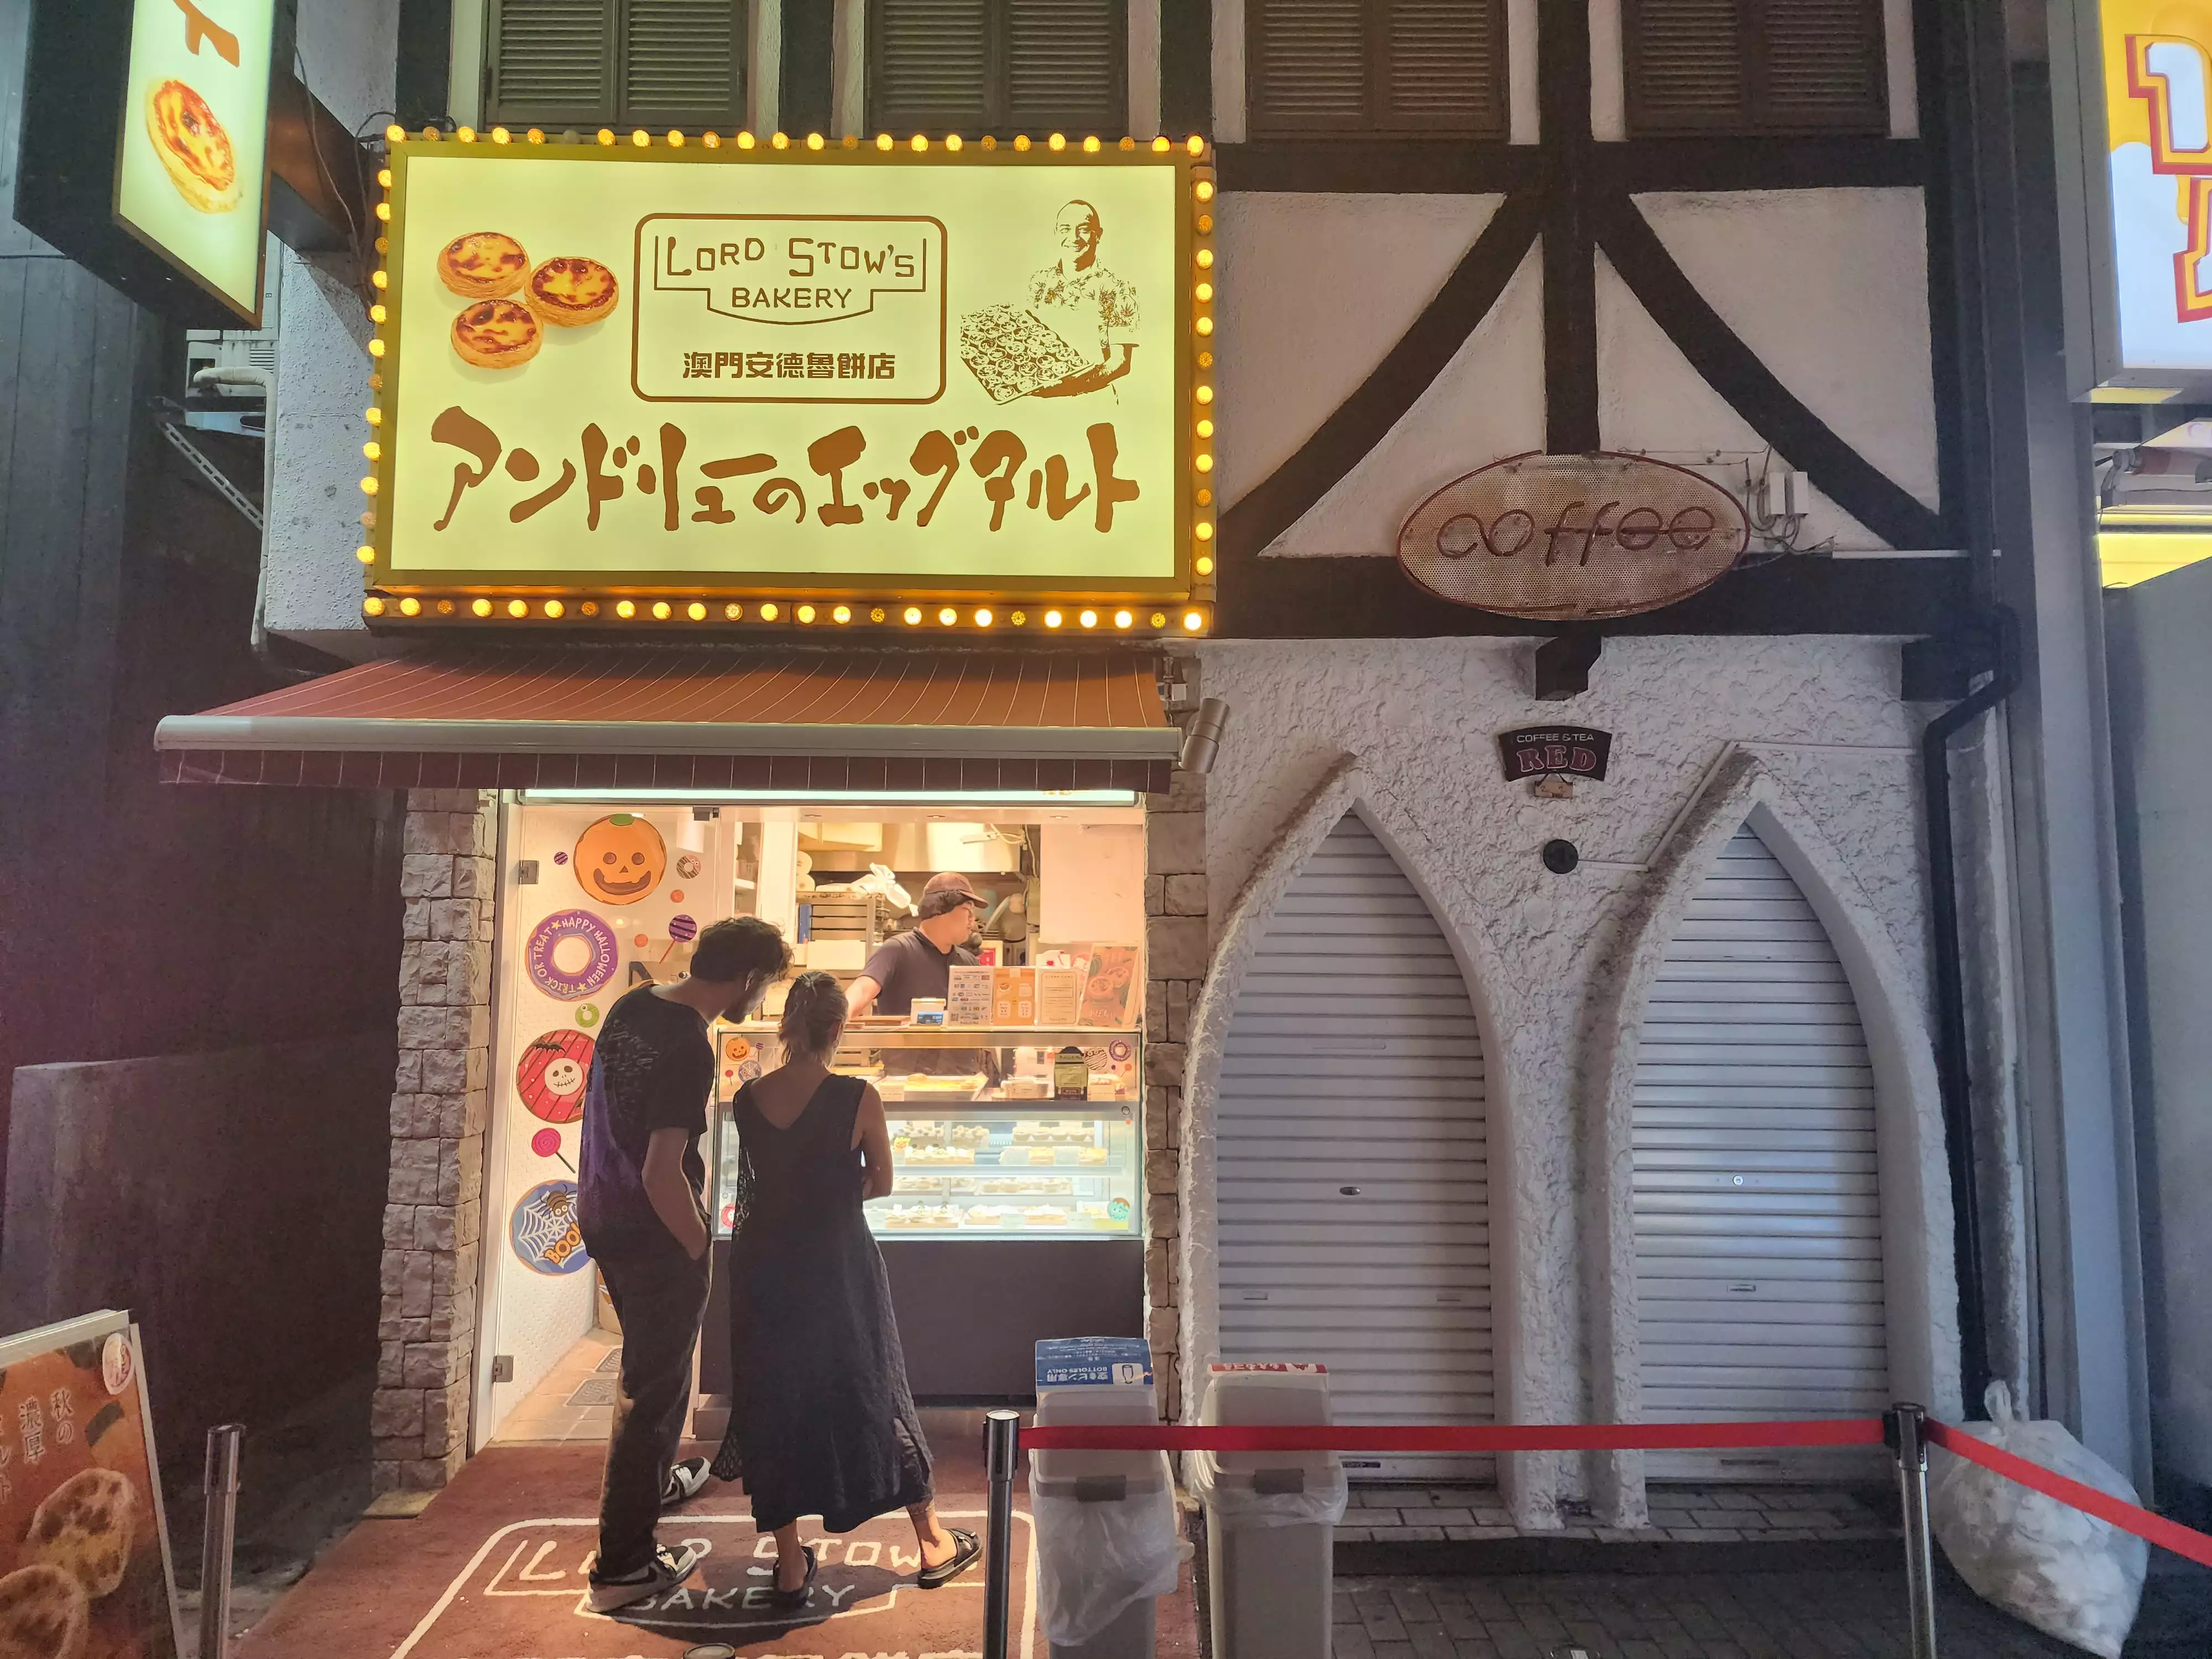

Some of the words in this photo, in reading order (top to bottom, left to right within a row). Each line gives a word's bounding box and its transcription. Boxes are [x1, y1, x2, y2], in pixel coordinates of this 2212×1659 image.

[667, 236, 765, 276] LORD
[788, 237, 915, 278] STOW'S
[732, 287, 853, 310] BAKERY
[682, 351, 896, 380] 澳門安德魯餅店
[430, 405, 1140, 533] アンドリューのエッグタルト
[1517, 733, 1559, 743] COFFEE
[1562, 733, 1571, 742] &
[1572, 733, 1594, 742] TEA
[1516, 745, 1597, 773] RED
[533, 926, 553, 960] TREAT
[561, 916, 596, 933] HAPPY
[587, 930, 611, 987] HALLOWEEN
[534, 962, 547, 978] OR
[544, 976, 577, 994] TRICK
[19, 1397, 45, 1462] 濃厚
[52, 1389, 74, 1442] 秋の
